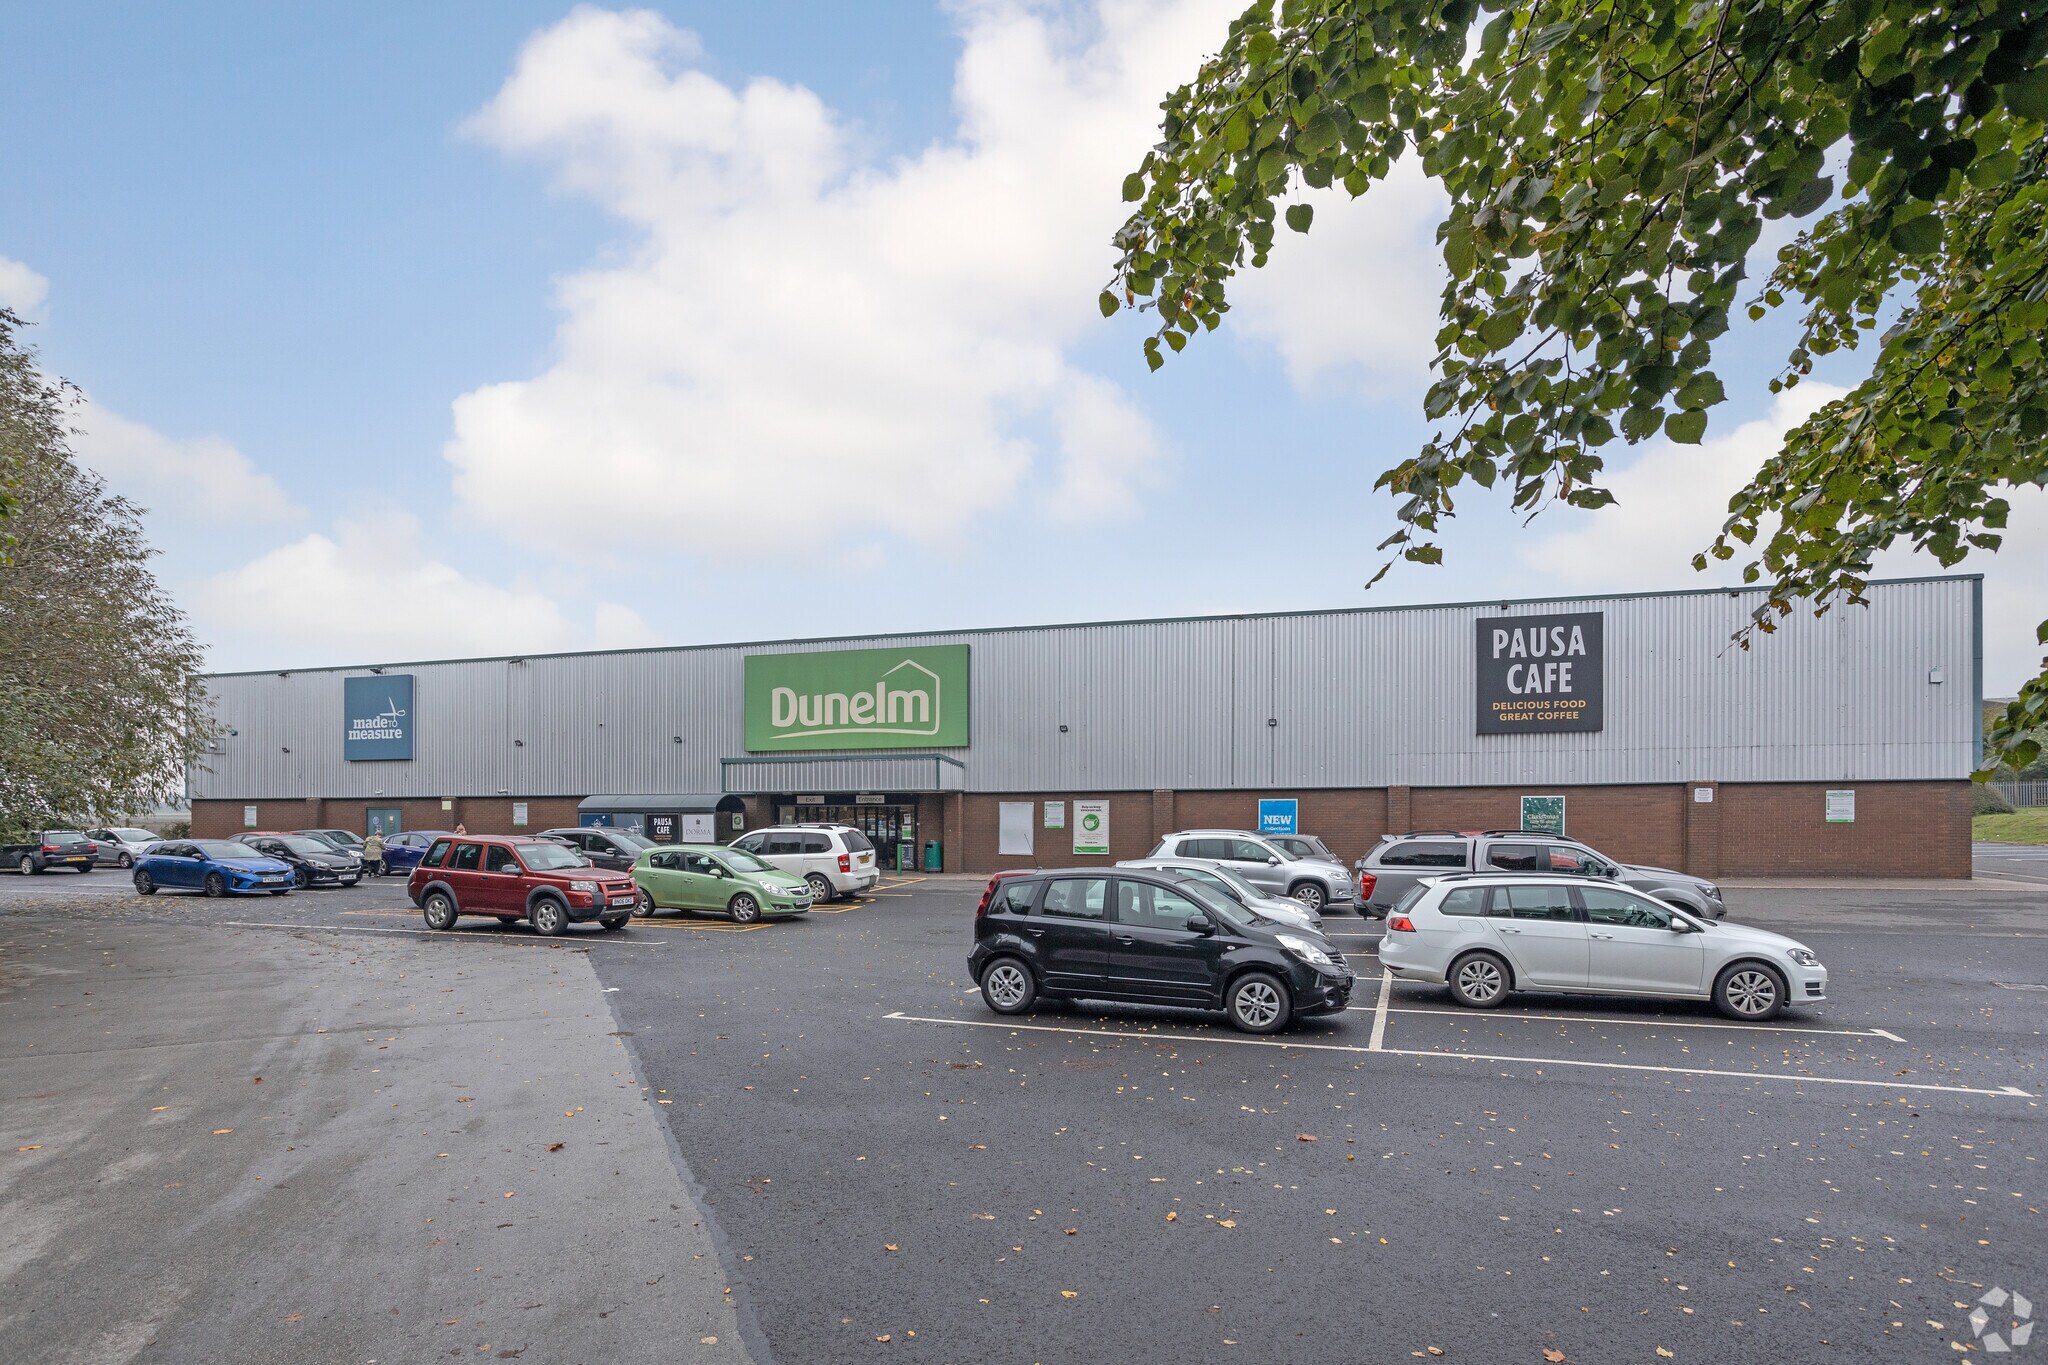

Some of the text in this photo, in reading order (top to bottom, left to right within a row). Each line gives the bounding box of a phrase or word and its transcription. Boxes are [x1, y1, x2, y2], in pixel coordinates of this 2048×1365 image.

[1493, 625, 1586, 659] PAUSA
[1507, 662, 1572, 695] CAFE
[771, 681, 930, 728] Dunelm
[1492, 700, 1586, 710] DELICIOUS FOOD
[1500, 711, 1579, 721] GREAT COFFEE
[353, 715, 398, 729] made TO
[348, 728, 403, 740] measure
[654, 818, 672, 826] PAUSA
[1264, 815, 1292, 824] NEW
[656, 826, 670, 834] CAFE
